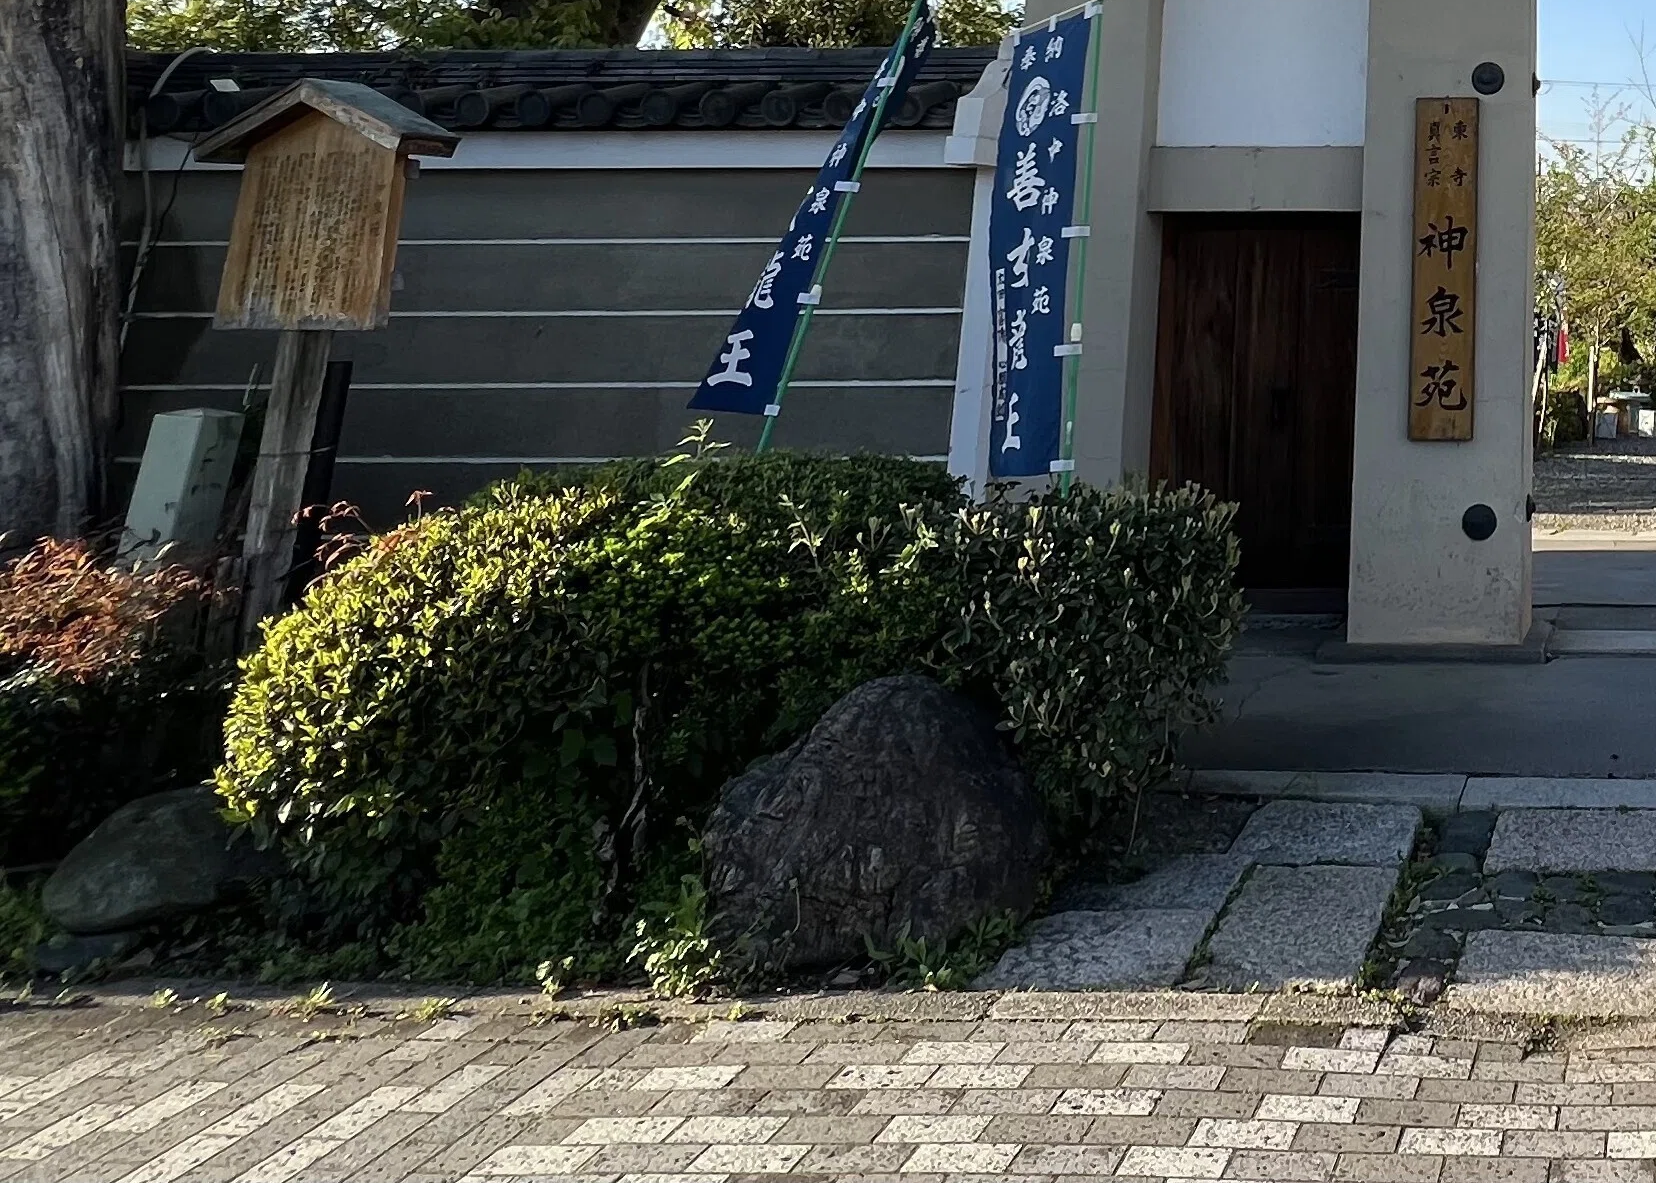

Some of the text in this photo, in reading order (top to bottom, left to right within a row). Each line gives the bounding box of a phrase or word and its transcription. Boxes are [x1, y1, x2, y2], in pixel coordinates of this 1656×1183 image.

[1020, 35, 1064, 72] 奉納
[1424, 121, 1442, 188] 真言宗
[1450, 121, 1469, 188] 東寺
[1030, 89, 1070, 315] 洛中神泉苑
[1414, 215, 1470, 412] 神泉苑
